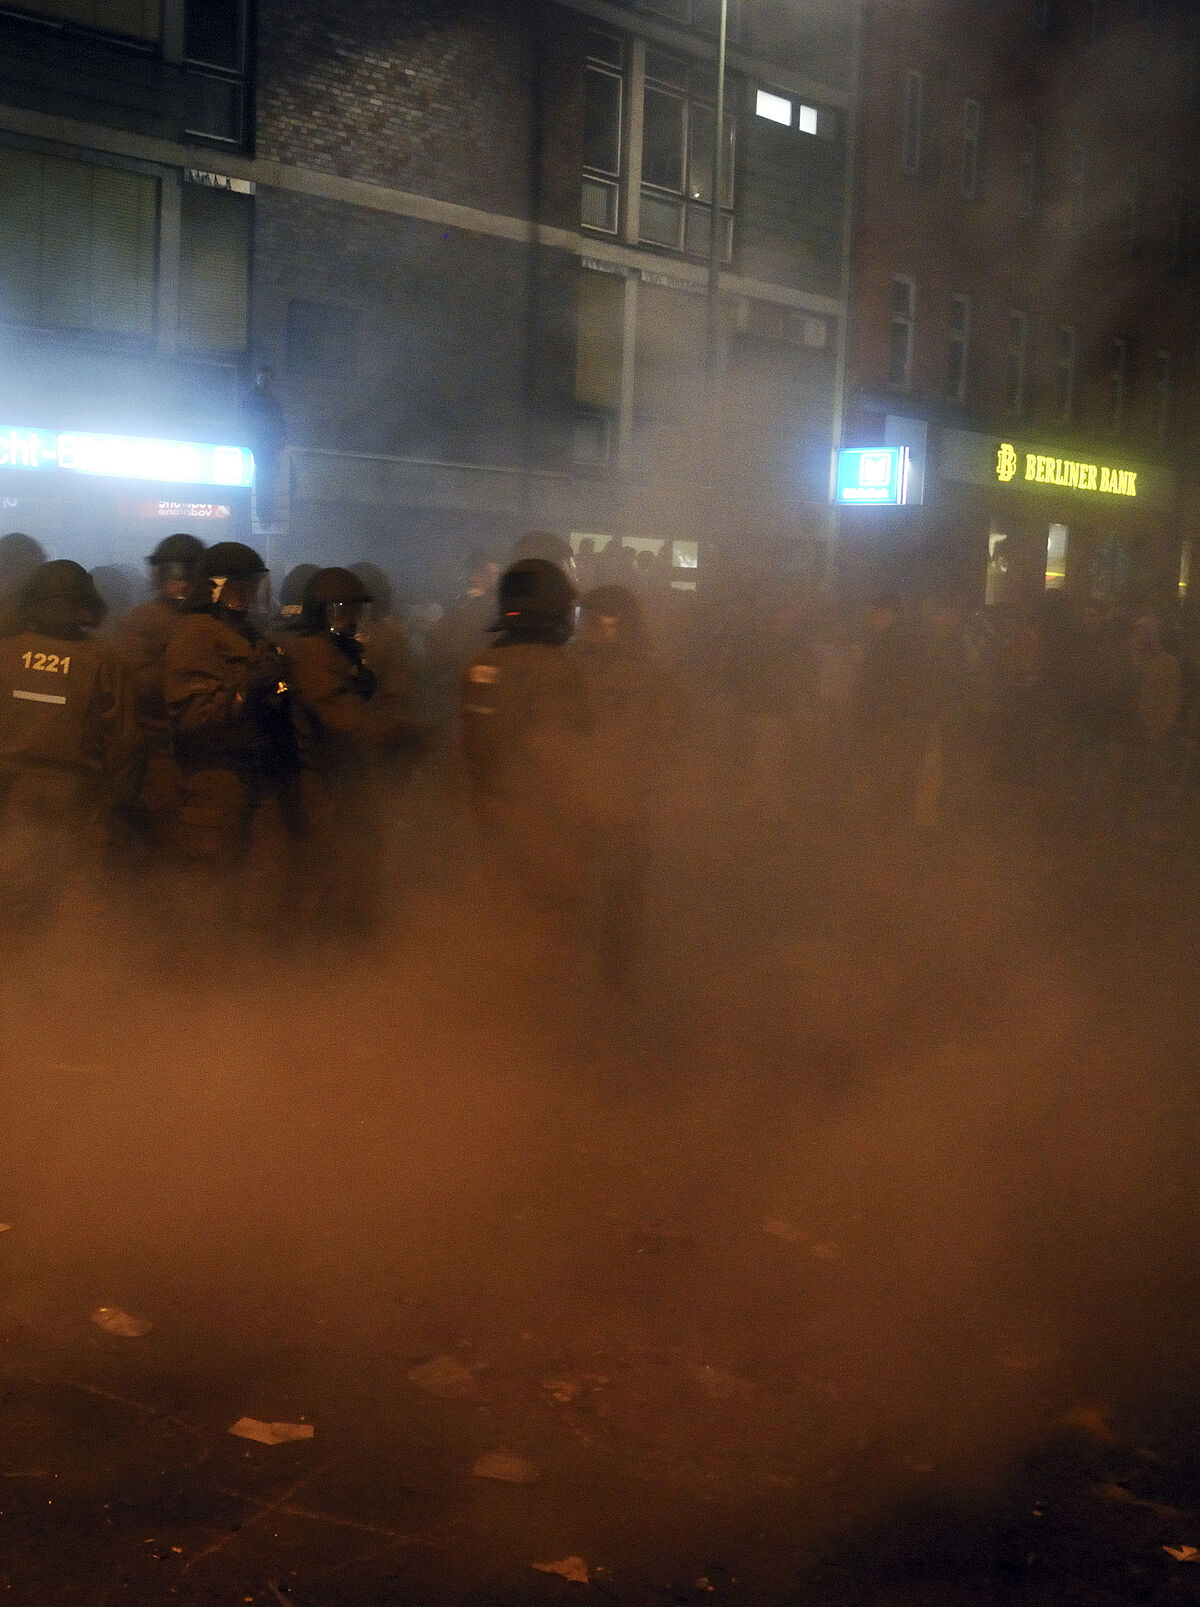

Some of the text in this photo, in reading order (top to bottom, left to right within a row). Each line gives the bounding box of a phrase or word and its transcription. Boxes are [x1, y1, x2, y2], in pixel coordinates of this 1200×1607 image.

[1025, 453, 1098, 491] BERLINER
[1099, 466, 1138, 497] BANK
[21, 651, 71, 674] 1221
